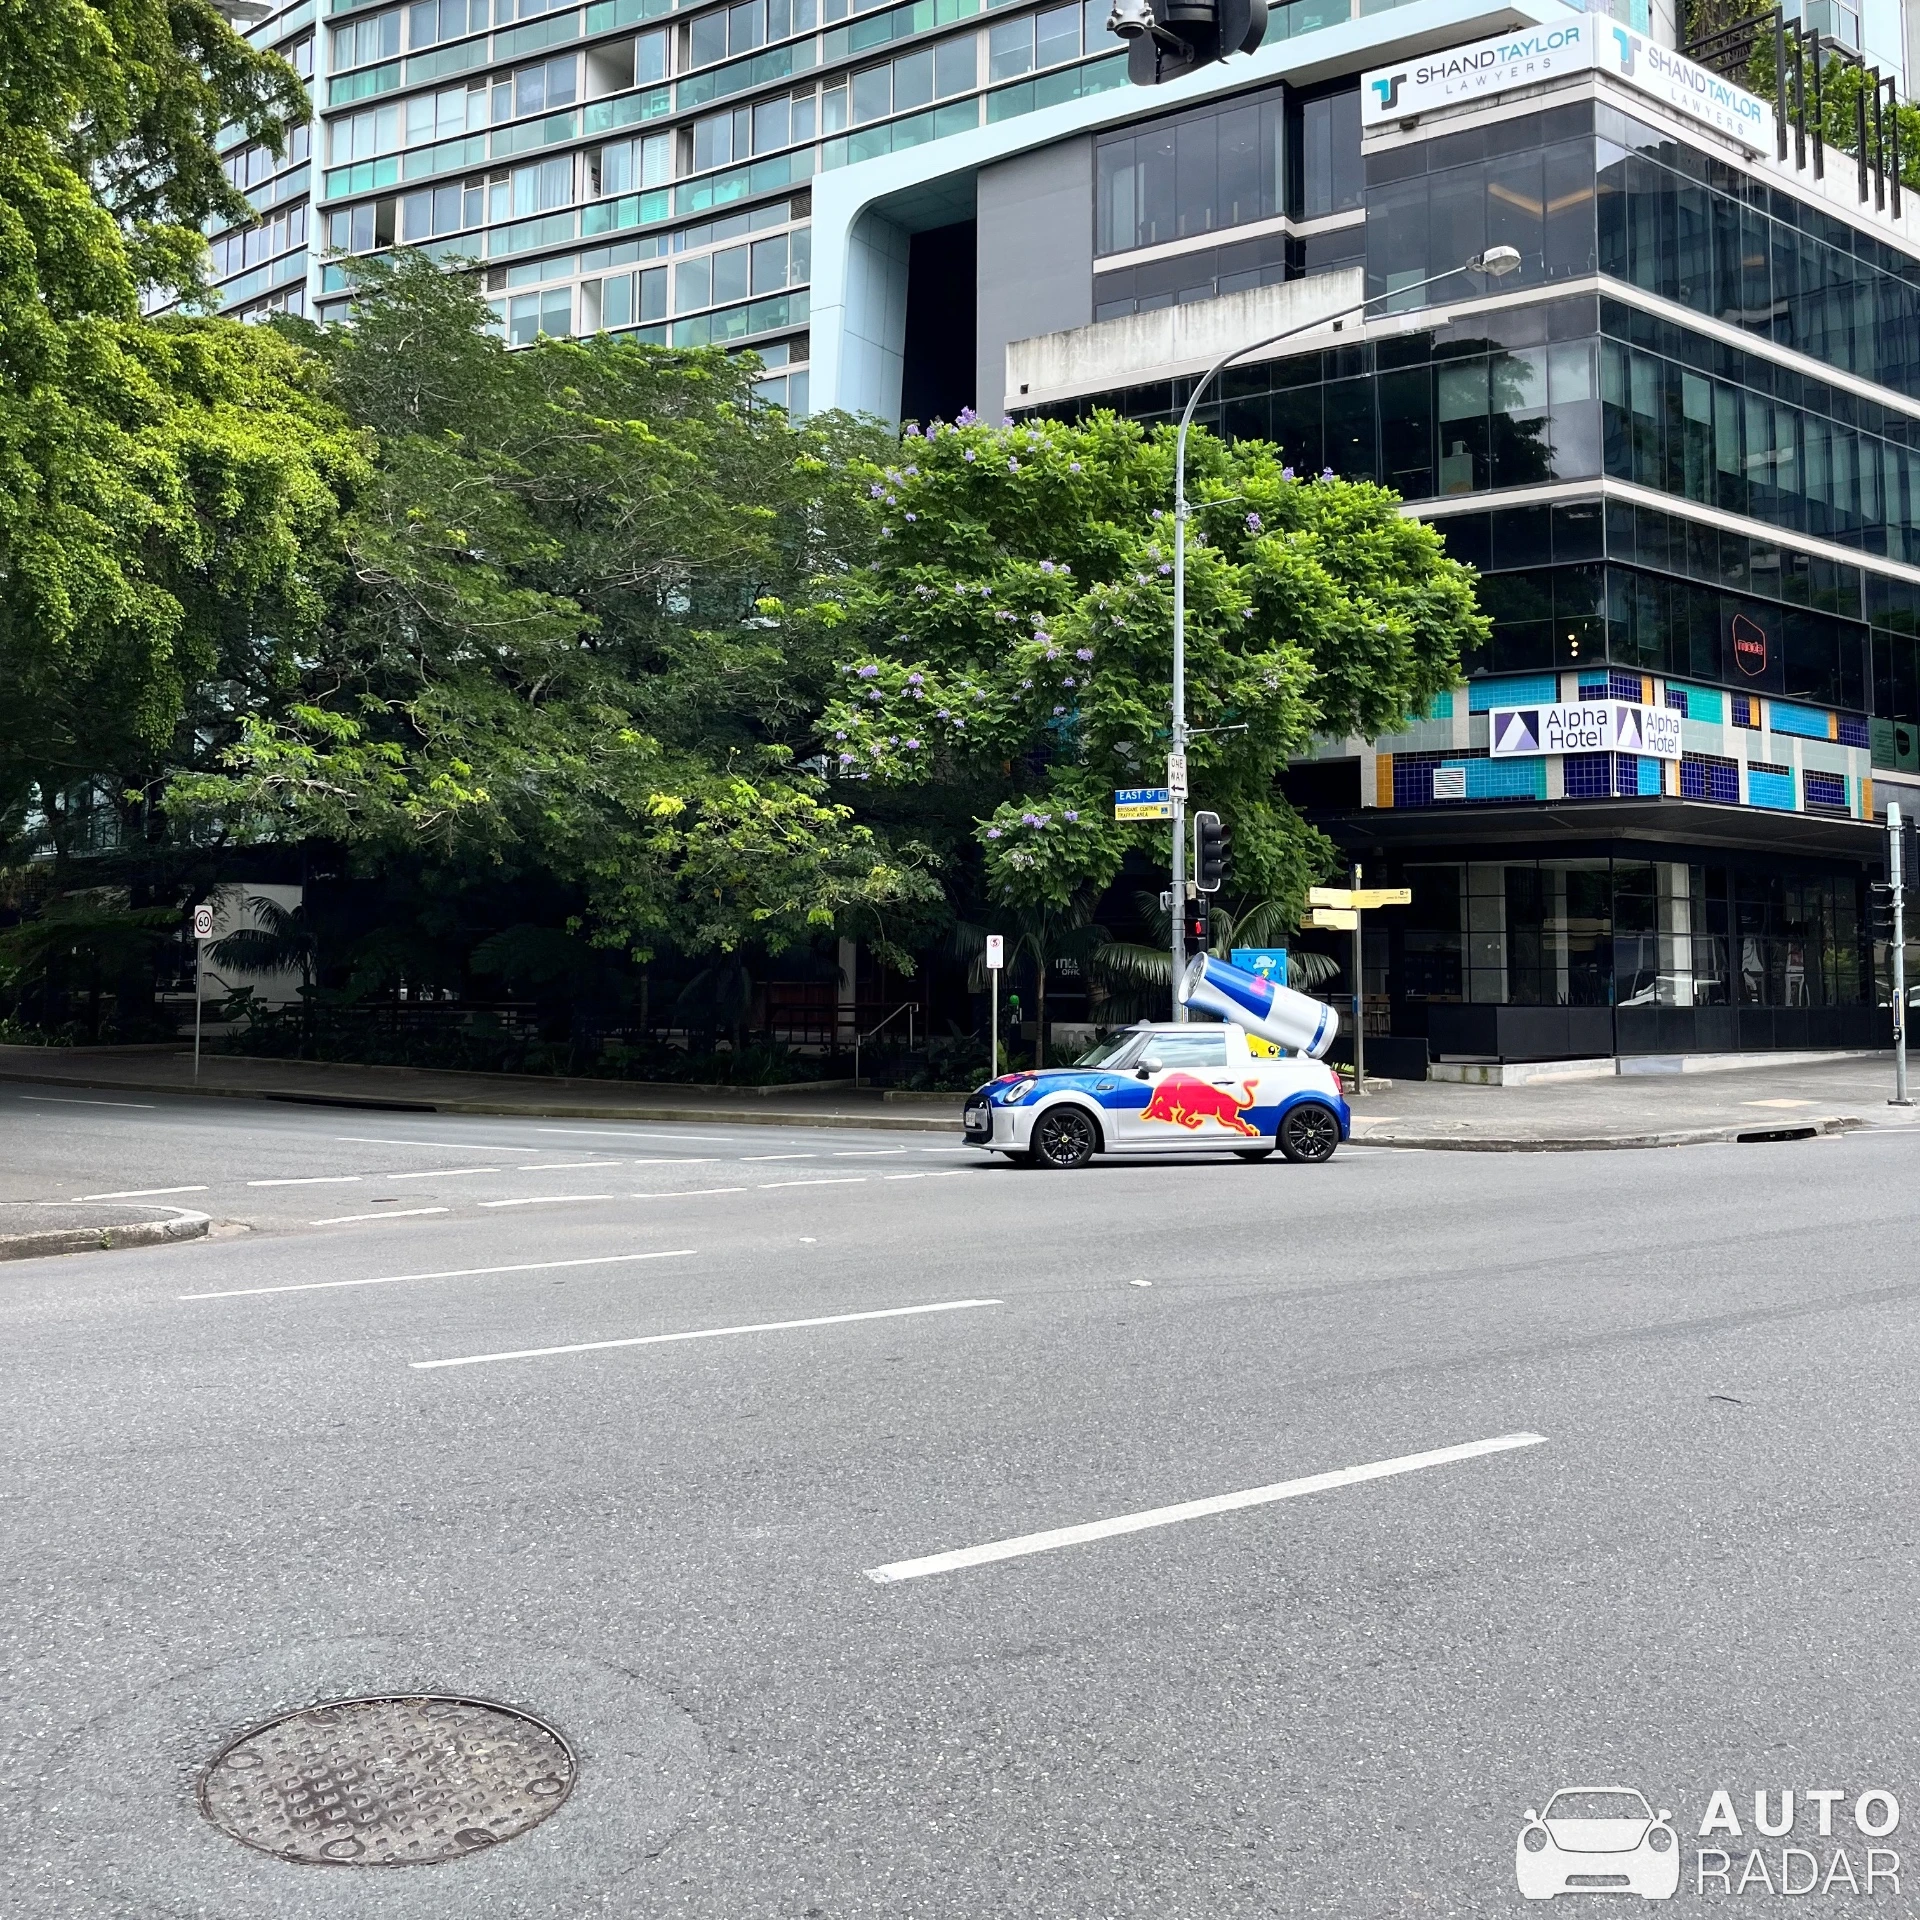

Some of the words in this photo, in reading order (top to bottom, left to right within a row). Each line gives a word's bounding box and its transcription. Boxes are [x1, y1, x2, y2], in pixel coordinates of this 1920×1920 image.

[1416, 26, 1580, 85] SHANDTAYLOR
[1445, 58, 1552, 95] LAWYERS
[1648, 47, 1762, 124] SHANDTAYLOR
[1670, 88, 1745, 136] LAWYERS
[1546, 707, 1608, 730] Alpha
[1645, 712, 1680, 734] Alpha
[1550, 727, 1604, 749] Hotel
[1648, 732, 1678, 754] Hotel
[1171, 758, 1184, 768] ONE
[1171, 772, 1184, 781] WAY
[1119, 790, 1142, 800] EAST
[198, 916, 210, 927] 60
